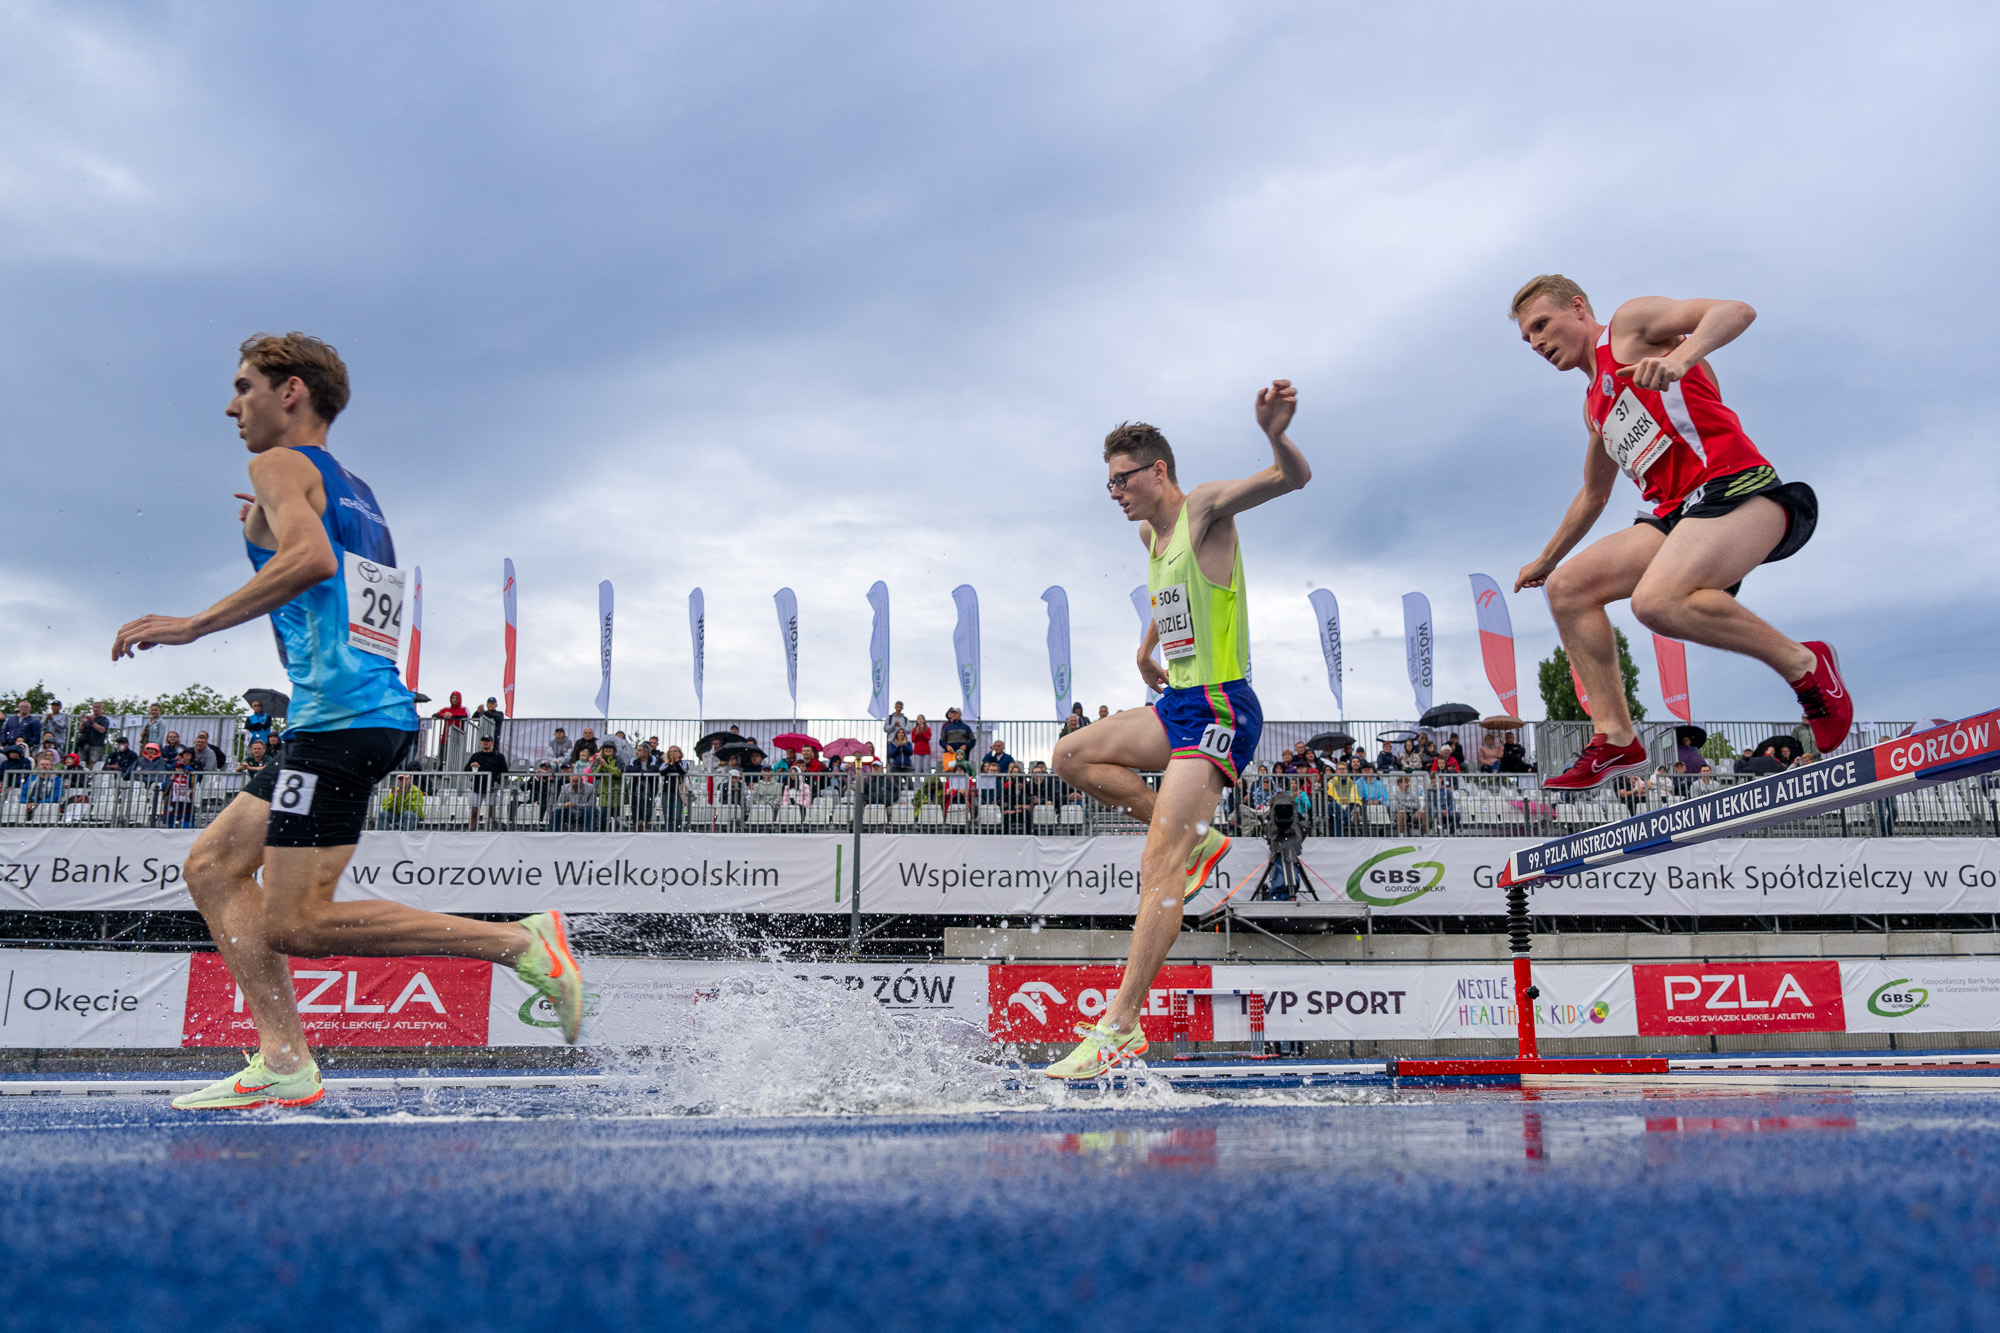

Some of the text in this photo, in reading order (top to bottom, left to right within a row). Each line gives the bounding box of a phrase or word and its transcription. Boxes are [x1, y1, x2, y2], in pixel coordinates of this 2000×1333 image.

[1615, 399, 1630, 422] 37
[1159, 588, 1180, 606] 506
[1205, 729, 1231, 753] 10
[1890, 722, 1990, 772] GORZÓW
[280, 774, 303, 809] 8
[1528, 760, 1857, 870] 99. PZLA MISTRZOSTWA POLSKI W LEKKIEJ ATLETYCE
[51, 856, 130, 883] Bank
[352, 866, 381, 885] w
[392, 859, 543, 886] Gorzowie
[553, 859, 780, 894] Wielkopolskim
[898, 862, 1058, 894] Wspieramy
[1370, 869, 1421, 884] GBS
[1667, 864, 1736, 890] Bank
[1745, 863, 1913, 896] Spółdzielczy
[1924, 870, 1949, 888] w
[1385, 884, 1420, 893] GORZÓW
[1663, 972, 1814, 1011] PZLA
[1921, 977, 1966, 986] Gospodarczy
[1967, 977, 1985, 985] Bank
[23, 987, 139, 1017] Okęcie
[1306, 990, 1406, 1015] SPORT
[1881, 993, 1914, 1003] GBS
[342, 1021, 391, 1030] LEKKIEJ
[393, 1021, 447, 1030] ATLETYKI
[1551, 1003, 1586, 1025] KIDS
[1667, 1012, 1815, 1023] POLSKI ZWIĄZEK LEKKIEJ ATLETYKI
